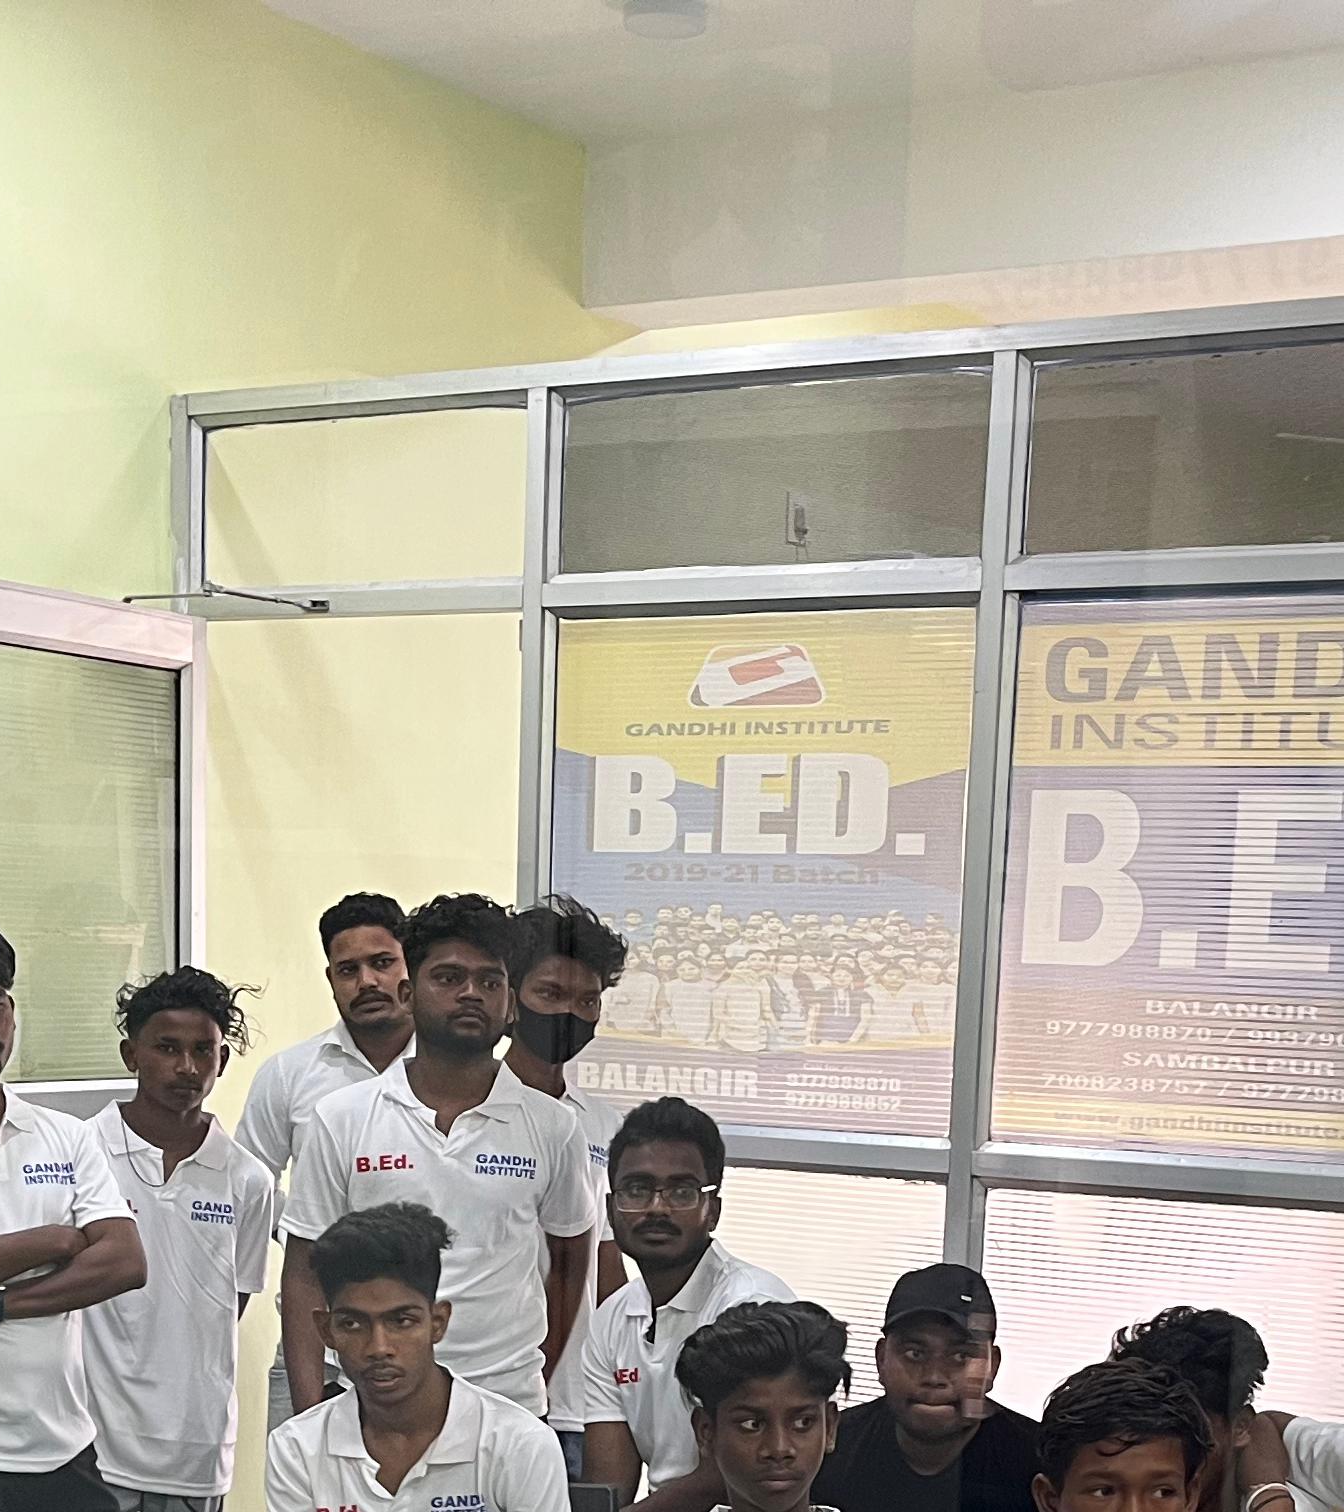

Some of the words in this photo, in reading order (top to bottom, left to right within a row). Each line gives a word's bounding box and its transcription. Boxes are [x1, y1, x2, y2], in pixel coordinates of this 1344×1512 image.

[625, 722, 737, 737] GANDHI
[744, 719, 892, 735] INSTITUTE
[592, 753, 926, 855] B.ED.
[623, 861, 760, 884] 2019-21
[773, 863, 882, 886] Batch
[1145, 1000, 1319, 1021] BALANGIR
[1122, 1052, 1336, 1077] SAMBALPUR
[577, 1062, 759, 1098] BALANGIR
[22, 1162, 74, 1175] GANDHI
[356, 1154, 414, 1173] B.Ed.
[476, 1154, 537, 1169] GANDHI
[475, 1165, 536, 1180] INSTITUTE
[431, 1495, 485, 1508] GAND
